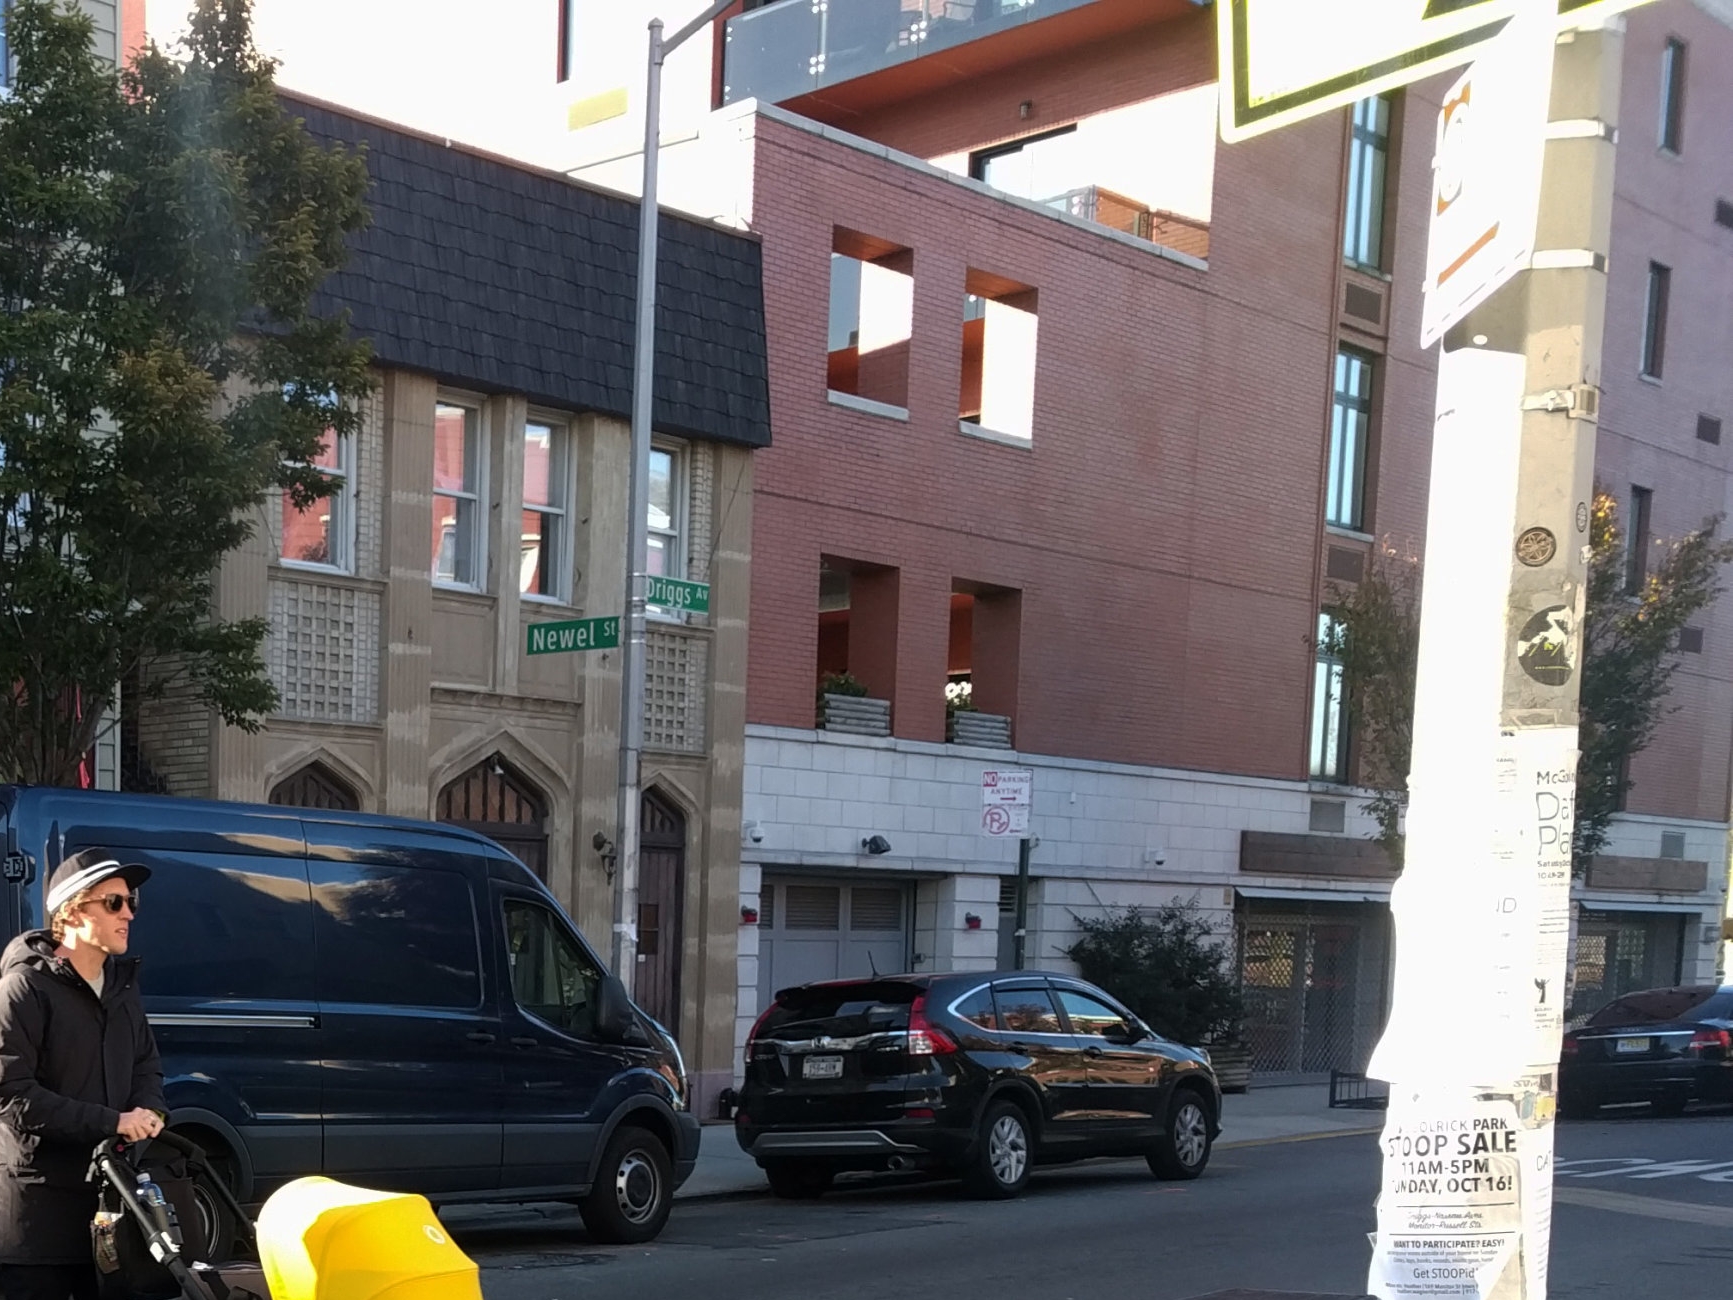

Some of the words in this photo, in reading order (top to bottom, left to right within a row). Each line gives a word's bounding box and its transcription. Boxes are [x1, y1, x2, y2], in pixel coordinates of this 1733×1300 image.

[647, 578, 691, 607] Driggs
[696, 587, 708, 600] Av
[533, 622, 595, 651] Newel
[603, 620, 615, 637] St
[985, 772, 996, 785] NO
[1473, 1118, 1508, 1131] PARK
[1457, 1131, 1517, 1155] SALE
[1402, 1158, 1489, 1175] 11AM-5PM
[1392, 1178, 1442, 1195] UNDAY,
[1447, 1177, 1481, 1193] OCT
[1485, 1176, 1512, 1191] 16!
[1393, 1240, 1409, 1248] WANT
[1423, 1240, 1480, 1249] PARTICIPATE?
[1482, 1239, 1505, 1248] EASY!
[1413, 1268, 1429, 1279] Get
